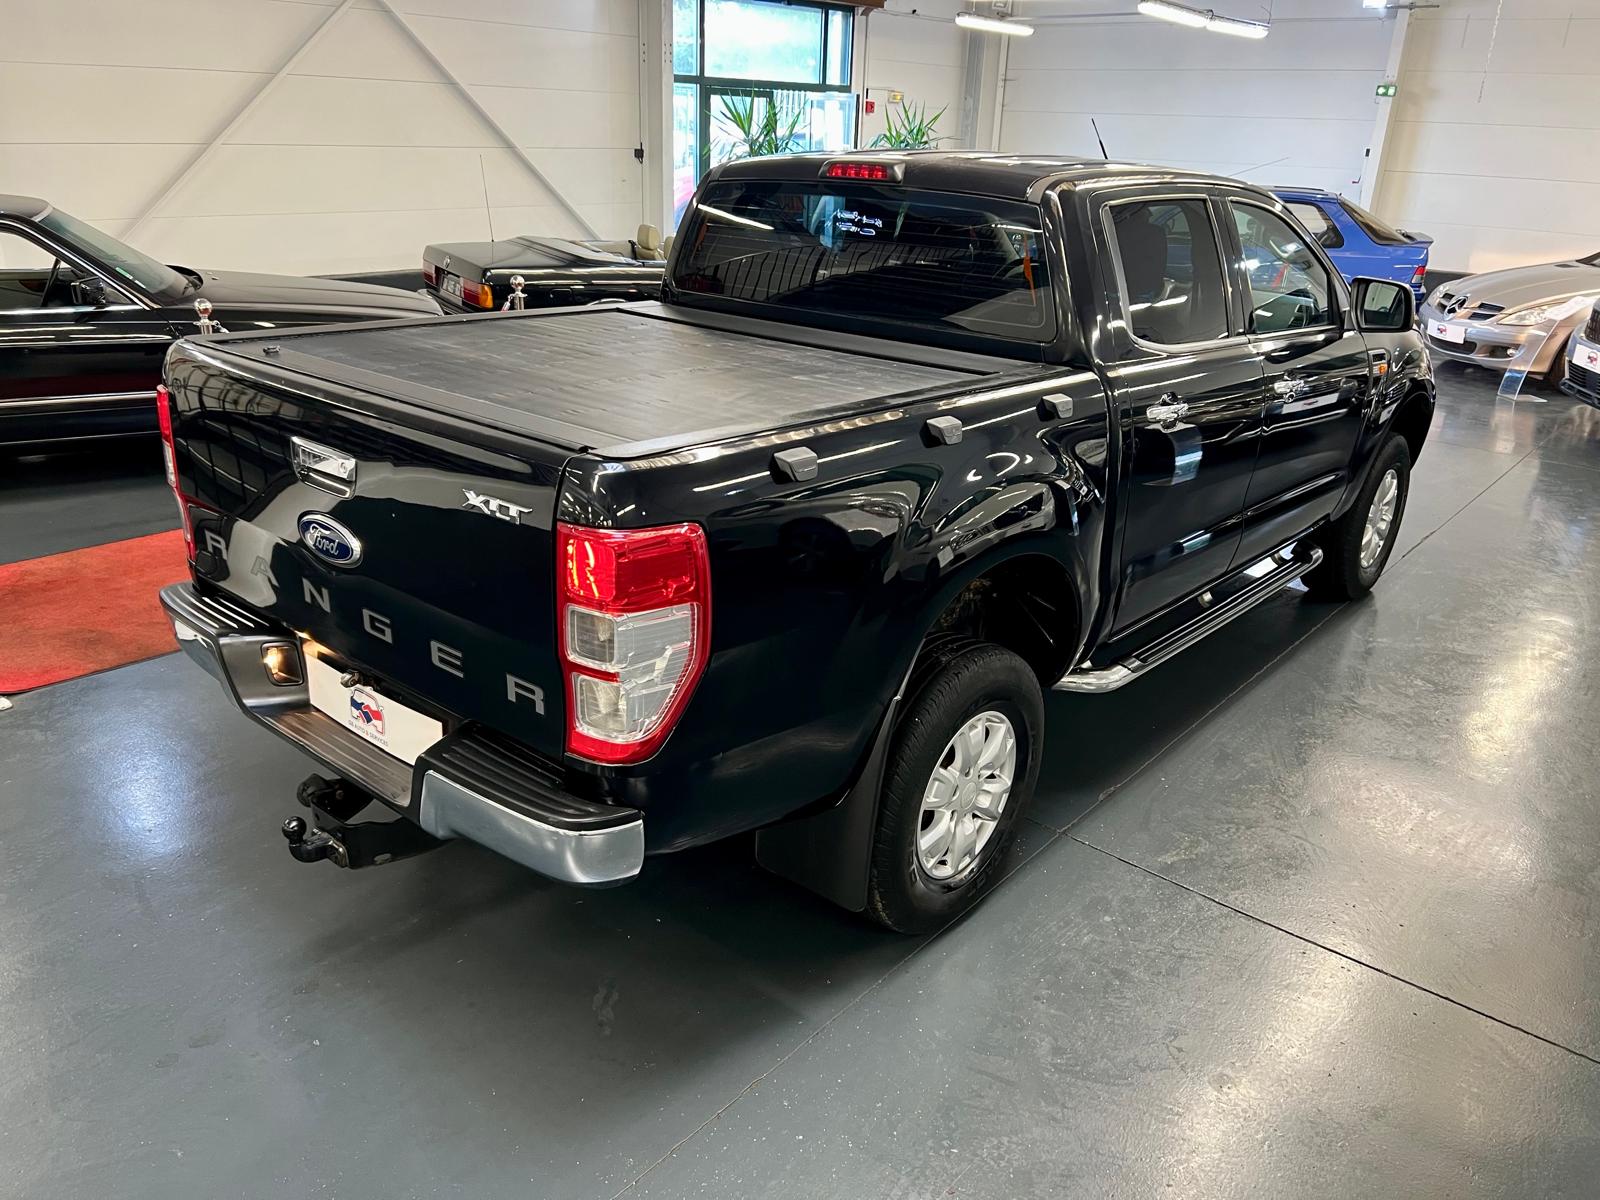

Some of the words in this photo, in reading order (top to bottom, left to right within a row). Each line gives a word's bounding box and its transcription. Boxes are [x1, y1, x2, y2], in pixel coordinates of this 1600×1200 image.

[462, 488, 533, 525] XLT
[307, 523, 340, 556] Ford
[203, 530, 545, 716] RANGER
